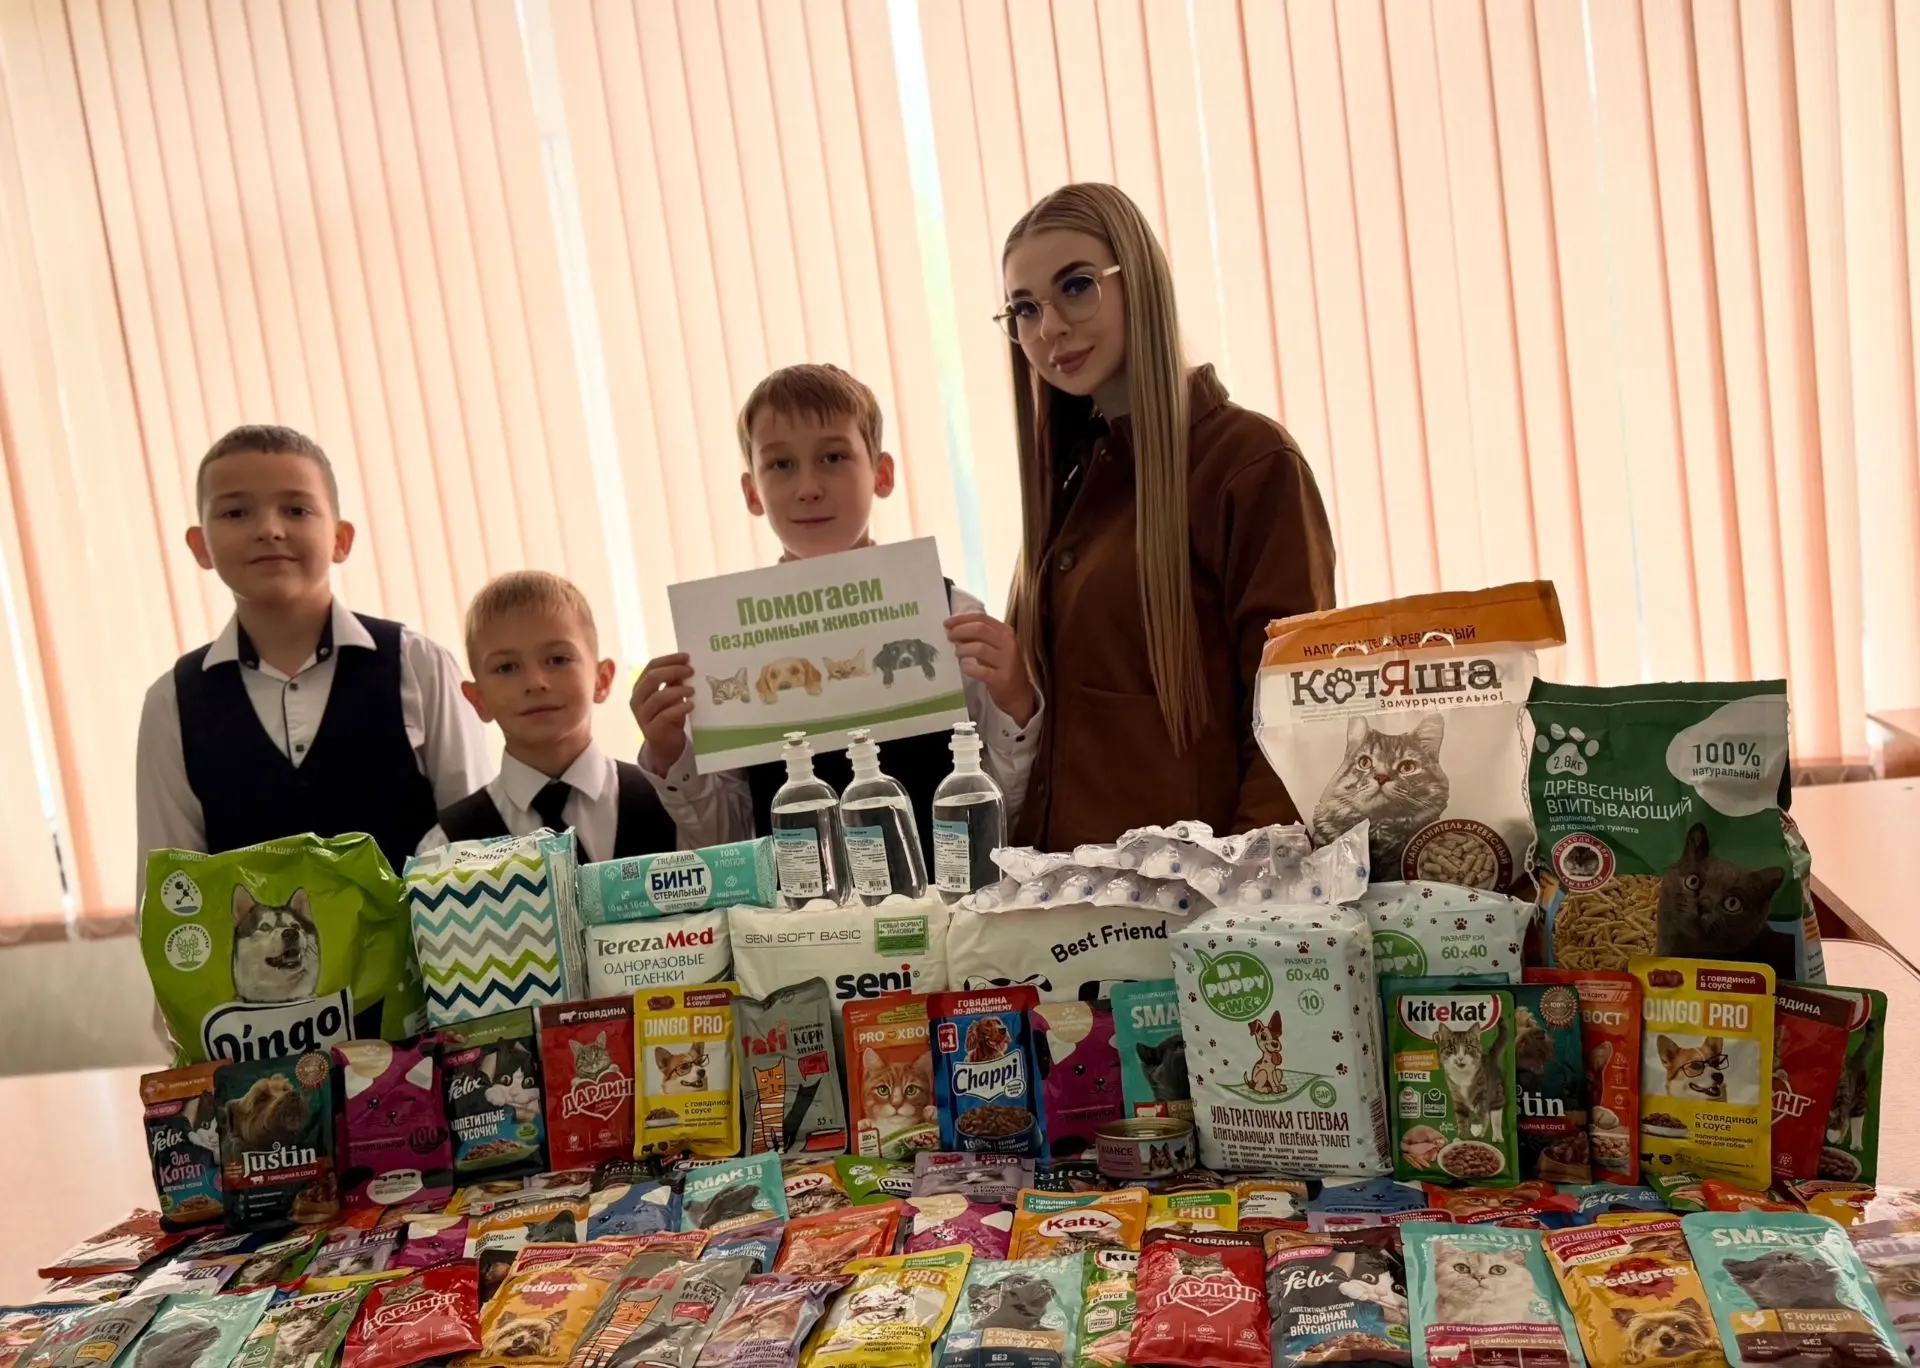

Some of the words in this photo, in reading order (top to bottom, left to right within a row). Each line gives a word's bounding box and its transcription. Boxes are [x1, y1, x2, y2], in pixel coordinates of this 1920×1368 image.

[736, 578, 883, 626] Помогаем
[709, 618, 820, 651] бездомным
[823, 602, 919, 633] животным
[1692, 742, 1760, 767] 100%
[1692, 766, 1760, 780] натуральный
[1543, 779, 1653, 802] ДРЕВЕСНЫЙ
[1546, 796, 1692, 821] ВПИТЫВАЮЩИЙ
[1550, 824, 1565, 832] для
[651, 867, 705, 891] БИНТ
[654, 887, 707, 900] СТЕРИЛЬНЫЙ
[594, 927, 714, 956] TerezaMed
[745, 934, 773, 944] SENI
[777, 931, 816, 943] SOFT
[820, 929, 861, 941] BASIC
[1050, 931, 1099, 963] Best
[1100, 920, 1168, 945] Friend
[604, 954, 704, 976] ОДНОРАЗОВЫЕ
[624, 970, 685, 986] ПЕЛЕНКИ
[835, 963, 912, 1000] seni
[1205, 975, 1266, 998] PUPPY
[1707, 974, 1756, 985] говядиной
[957, 996, 1008, 1008] ГОВЯДИНА
[1302, 995, 1320, 1011] 10
[1407, 1000, 1488, 1022] kitekat
[578, 1007, 627, 1021] ГОВЯДИНА
[1708, 1003, 1748, 1029] PRO
[213, 1005, 342, 1062] Dingo
[644, 1016, 689, 1037] DINGO
[693, 1014, 723, 1034] PRO
[858, 1031, 885, 1045] PRO
[953, 1058, 1018, 1094] Chappi
[448, 1074, 482, 1104] felix
[1211, 1105, 1294, 1130] УЛЬТРАТОНКАЯ
[1297, 1111, 1350, 1131] ГЕЛЕВАЯ
[1702, 1112, 1758, 1125] говядиной
[1703, 1121, 1732, 1132] соусе
[152, 1129, 184, 1158] felix
[1213, 1127, 1275, 1145] ВПИТЫВАЮЩАЯ
[241, 1141, 318, 1179] Justin
[786, 1176, 824, 1192] atty
[1178, 1206, 1216, 1219] PRO
[1047, 1216, 1114, 1232] Katty
[1188, 1236, 1251, 1247] ГОВЯДИНА
[1283, 1270, 1335, 1298] felix
[1586, 1266, 1689, 1288] Pedigree
[1157, 1280, 1262, 1309] ДАРЛИНГ
[1290, 1319, 1359, 1337] ВКУСНЯТИНА
[1298, 1309, 1347, 1325] ДВОЙНАЯ
[1427, 1325, 1445, 1333] ДЛЯ
[1447, 1324, 1527, 1333] СТЕРИЛИЗОВАННЫХ
